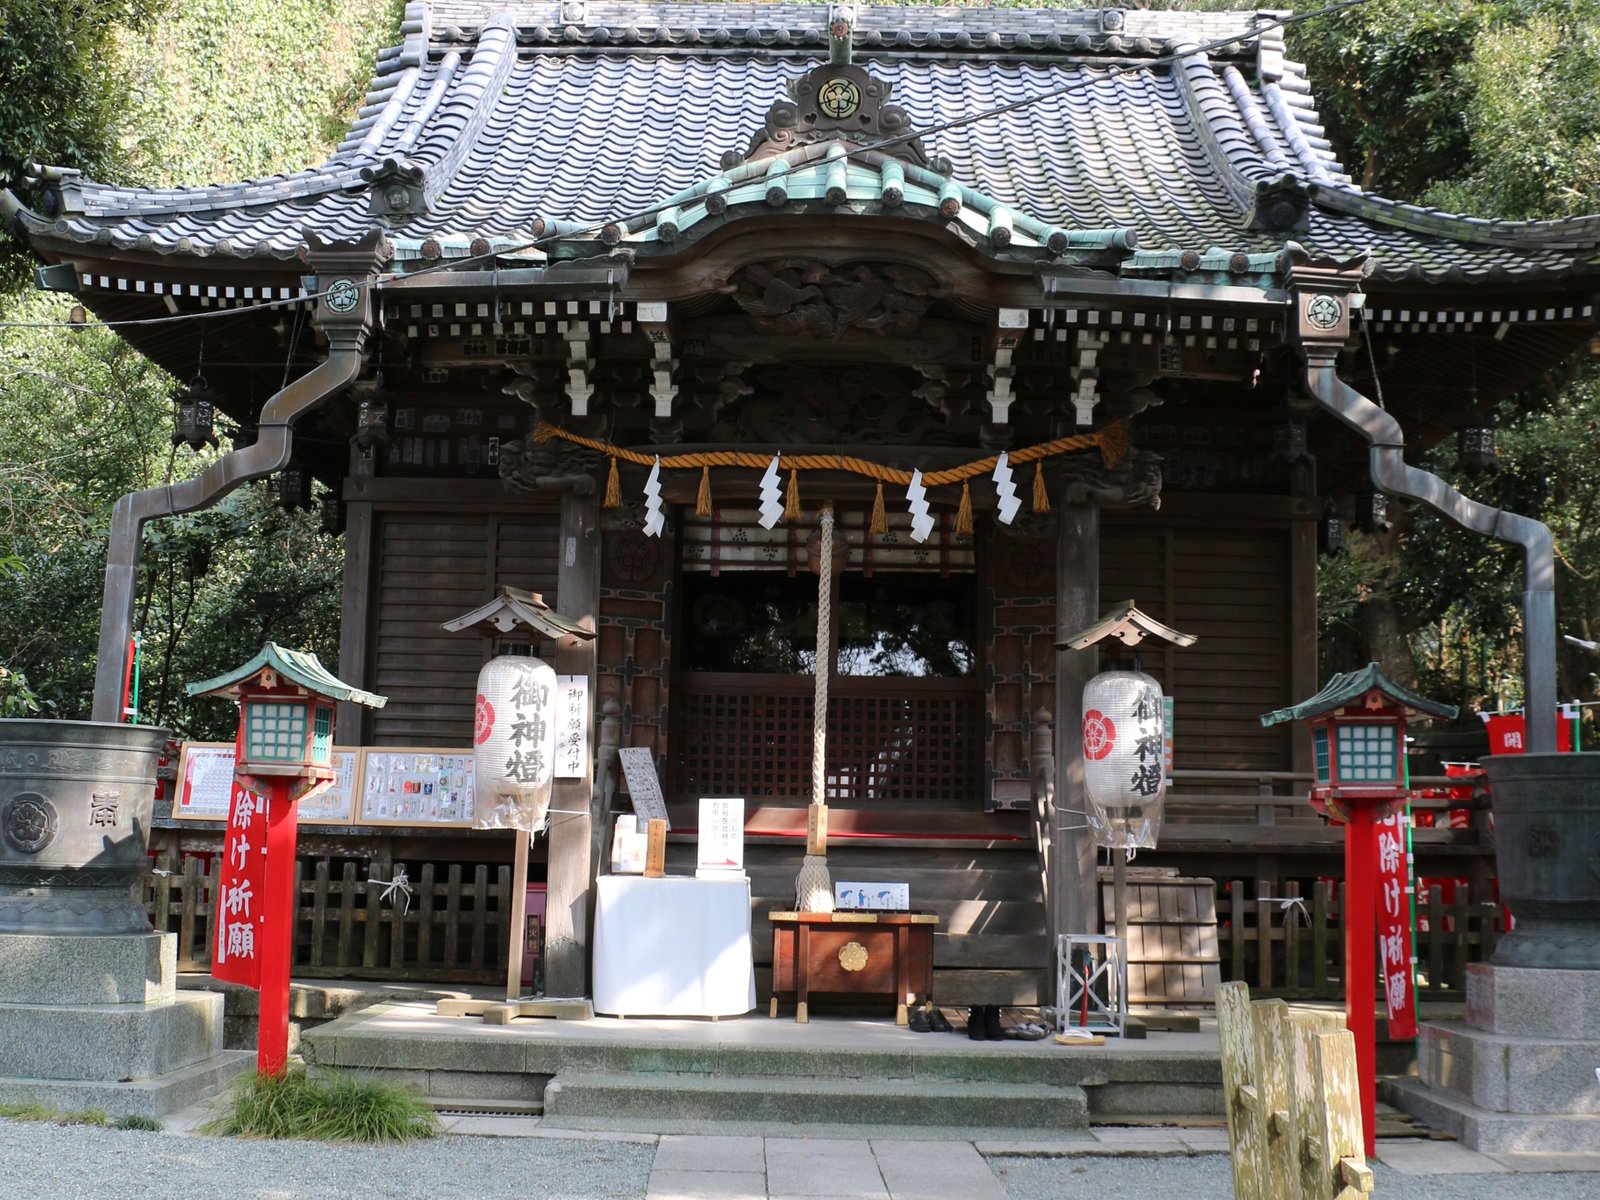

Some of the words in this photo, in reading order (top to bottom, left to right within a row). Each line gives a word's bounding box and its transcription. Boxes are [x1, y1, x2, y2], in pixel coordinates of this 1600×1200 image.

[505, 674, 549, 784] 御神燈
[567, 688, 584, 774] 御祈願受付中
